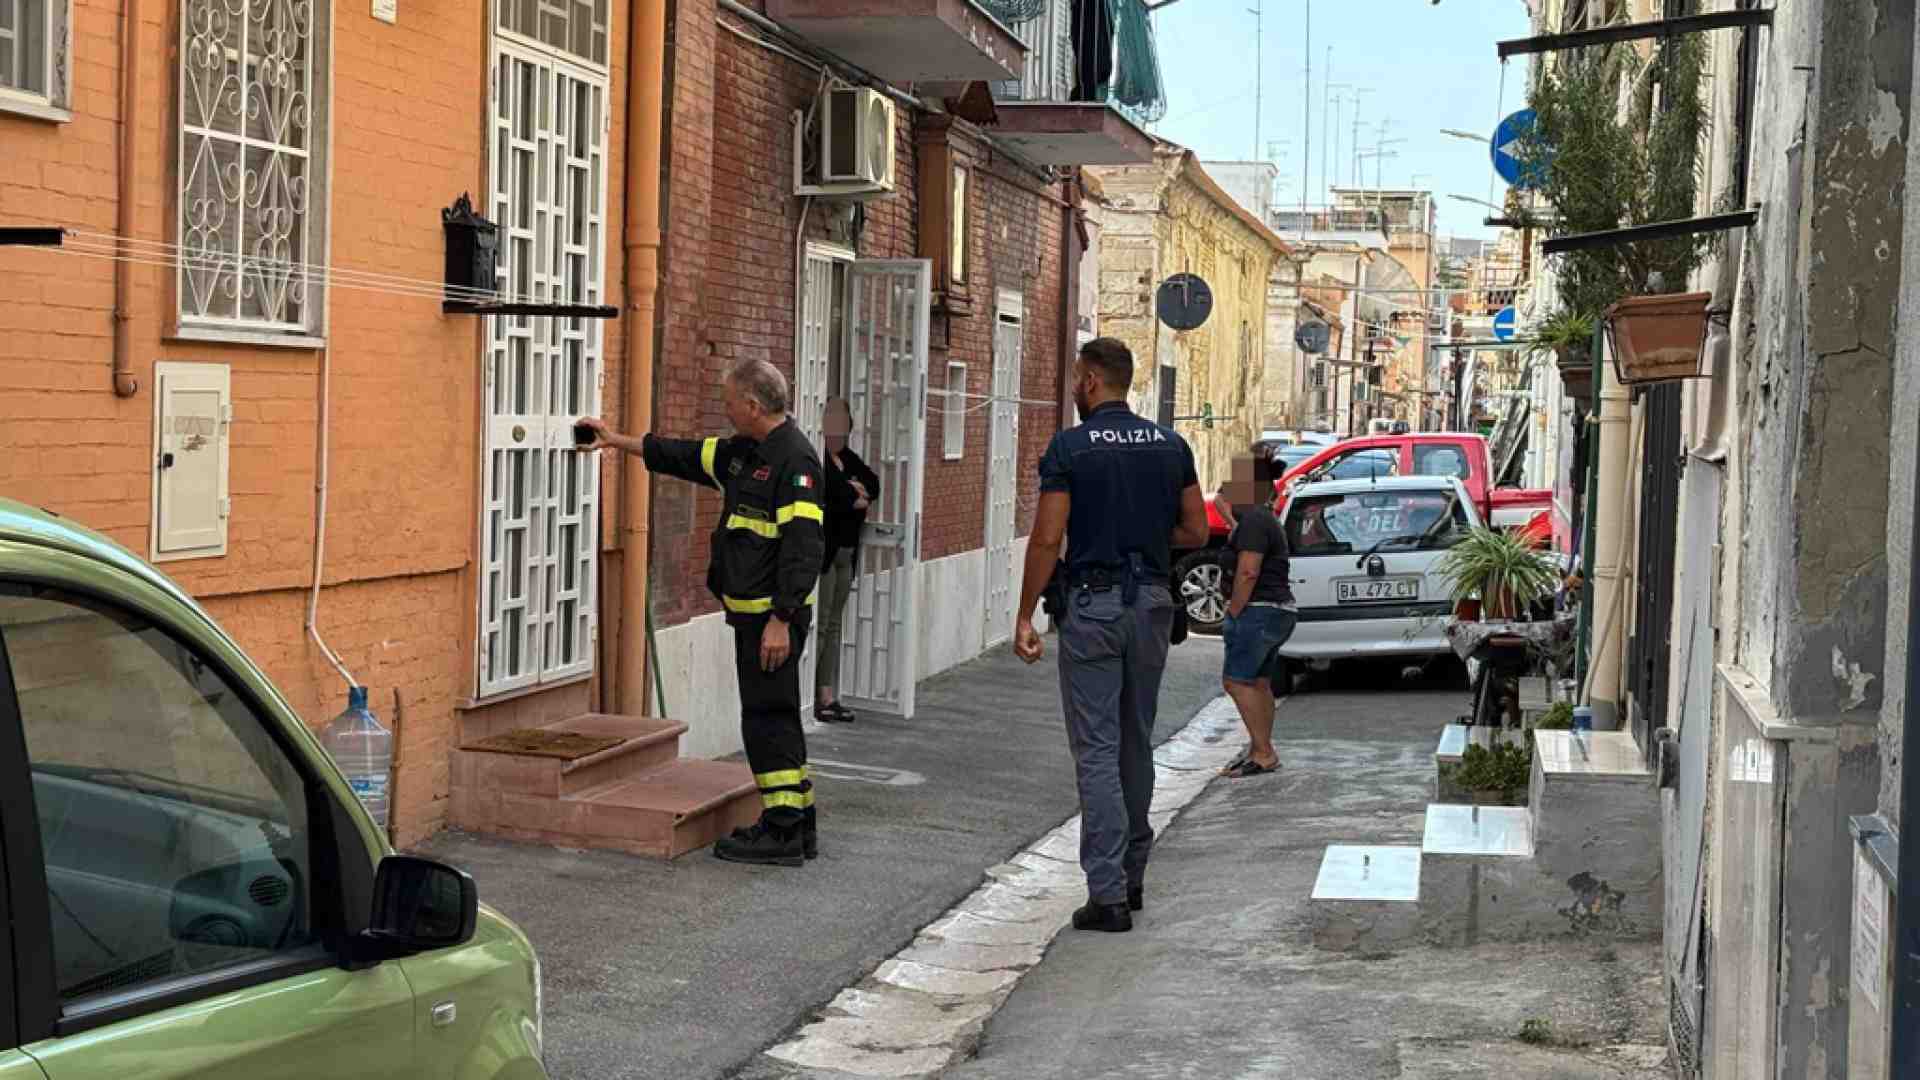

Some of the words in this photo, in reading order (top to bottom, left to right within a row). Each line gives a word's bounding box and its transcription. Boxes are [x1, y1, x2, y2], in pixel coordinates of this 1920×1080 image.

[1089, 428, 1167, 444] POLIZIA
[1340, 584, 1358, 598] BA
[1366, 583, 1393, 597] 472
